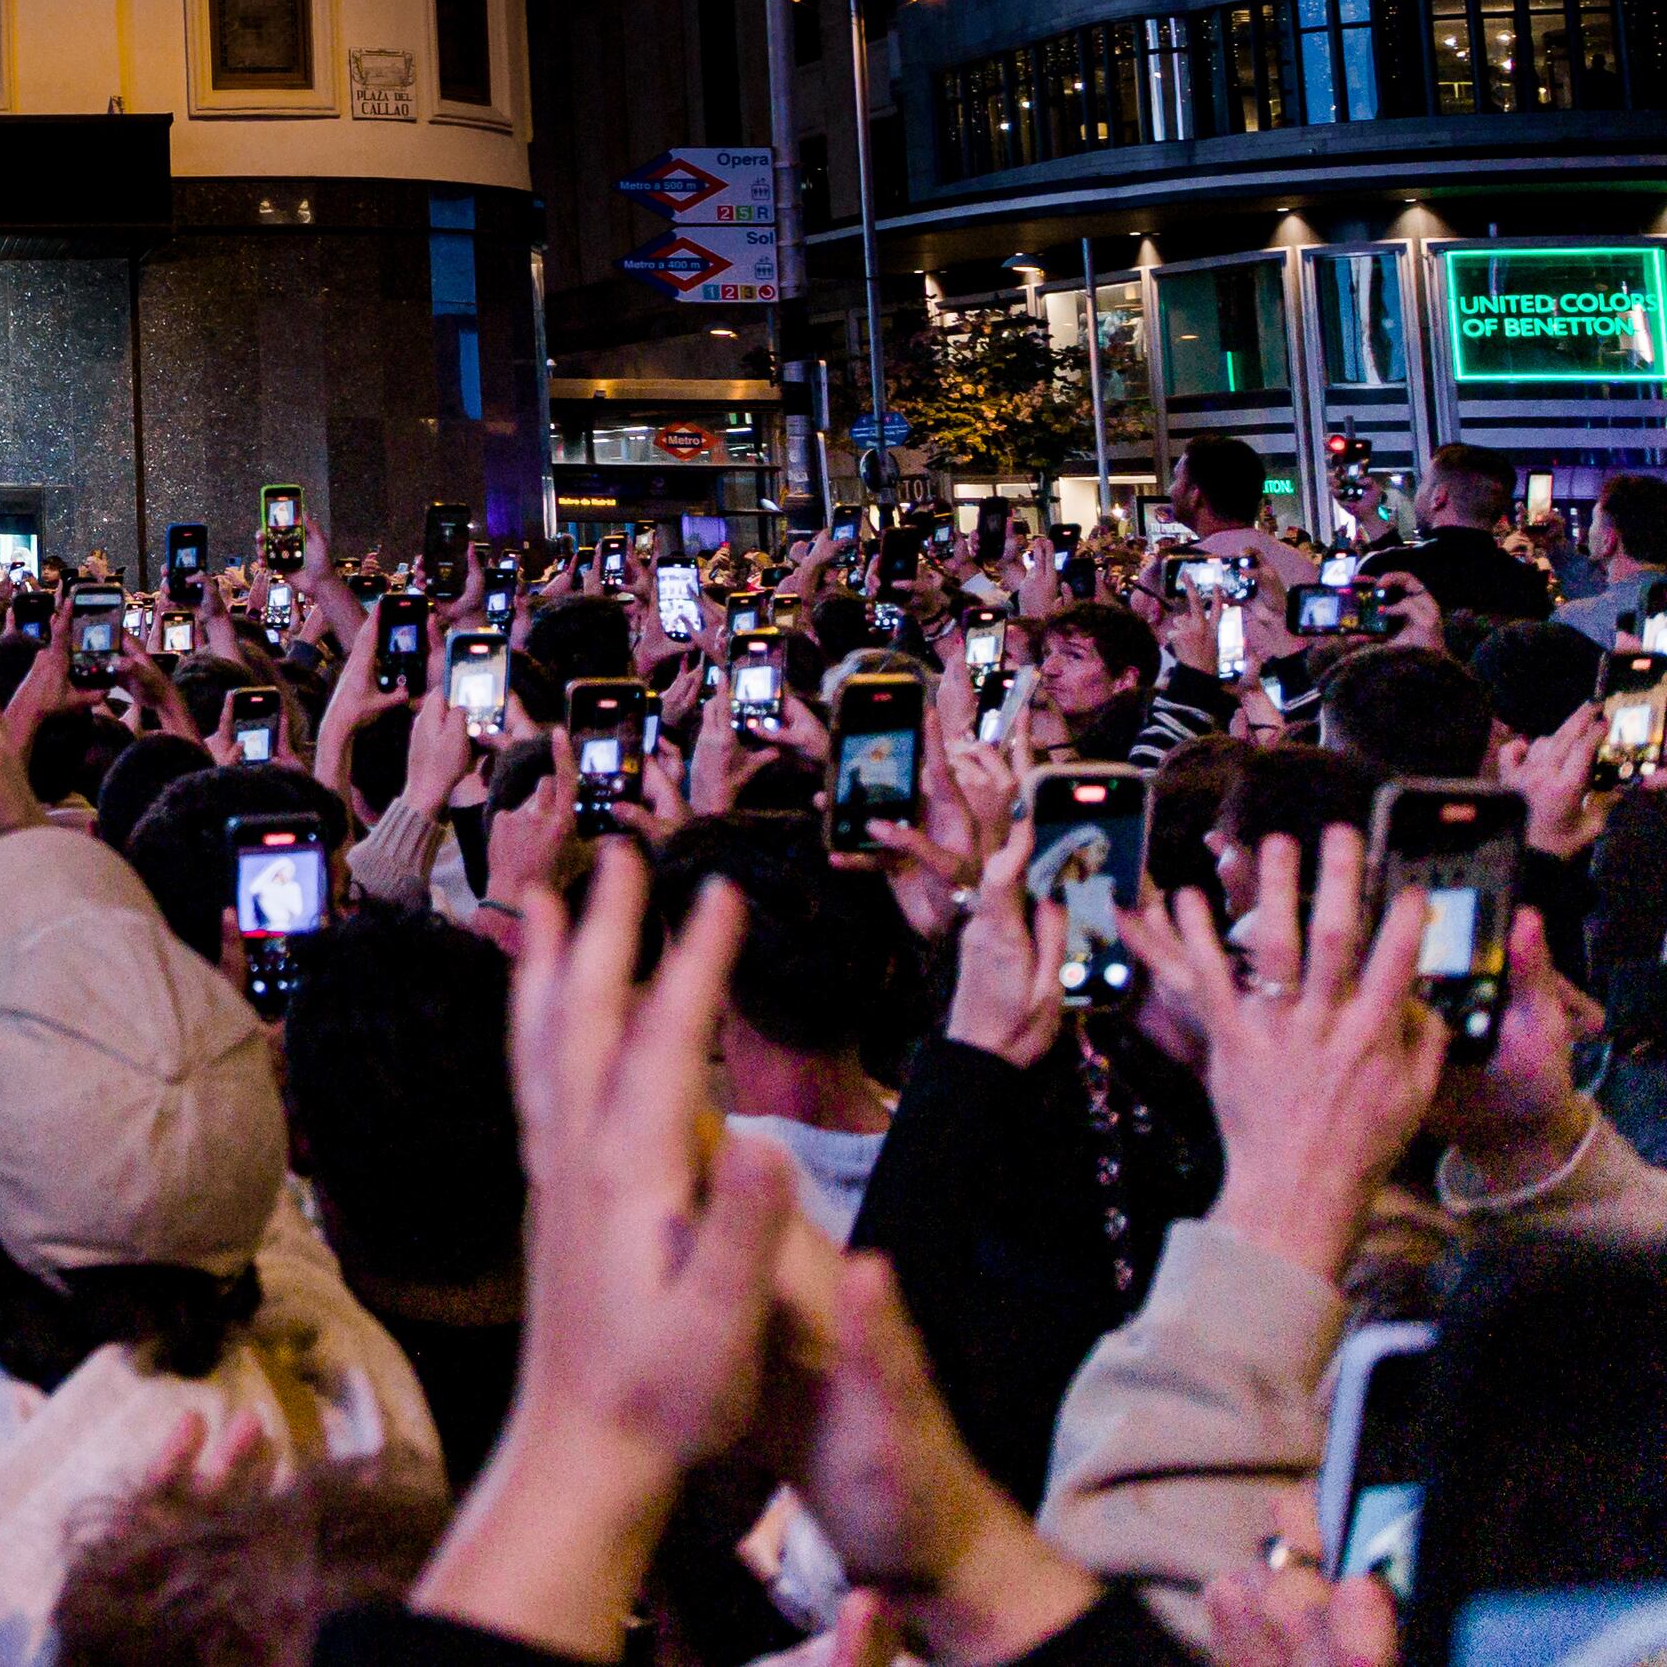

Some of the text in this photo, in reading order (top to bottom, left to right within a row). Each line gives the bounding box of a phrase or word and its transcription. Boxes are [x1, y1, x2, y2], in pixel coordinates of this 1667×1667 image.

[356, 90, 413, 102] PLAZA DEL
[361, 101, 409, 117] CALLAO
[619, 181, 650, 191] Metro
[664, 180, 683, 191] 500
[686, 182, 697, 191] m
[746, 231, 774, 245] Sol
[624, 260, 655, 270] Metro
[668, 260, 687, 270] 400
[691, 261, 701, 270] m
[1460, 292, 1659, 314] UNITED COLORS
[1462, 317, 1497, 337] OF
[667, 434, 701, 446] Metro
